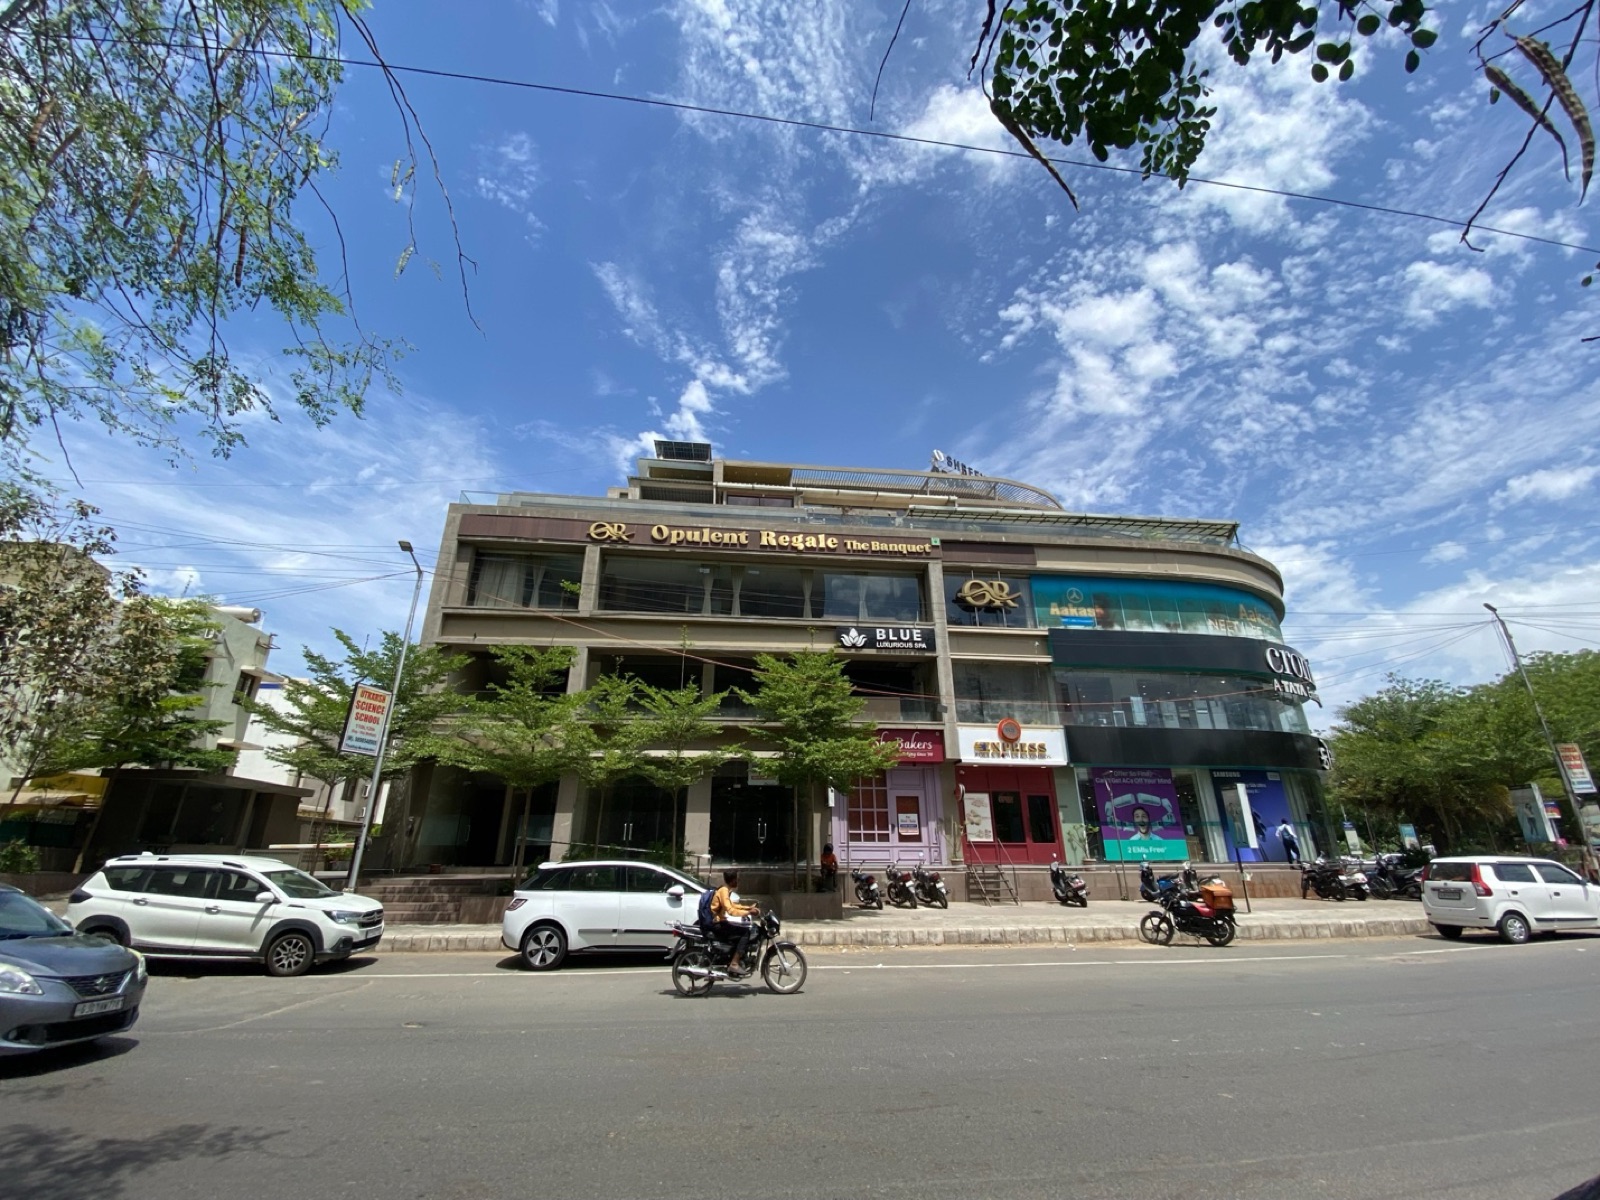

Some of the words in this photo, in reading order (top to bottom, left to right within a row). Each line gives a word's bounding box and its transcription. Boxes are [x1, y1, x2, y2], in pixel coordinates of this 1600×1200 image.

[946, 455, 983, 477] SHREE
[651, 524, 749, 545] Opulent
[759, 530, 839, 551] Regale
[844, 539, 869, 551] The
[871, 541, 932, 555] Banquet
[876, 628, 922, 641] BLUE
[876, 641, 913, 649] LUXURIOUS
[355, 700, 385, 715] SCIENCE
[355, 711, 380, 725] SCHOOL
[895, 731, 933, 750] Bakers
